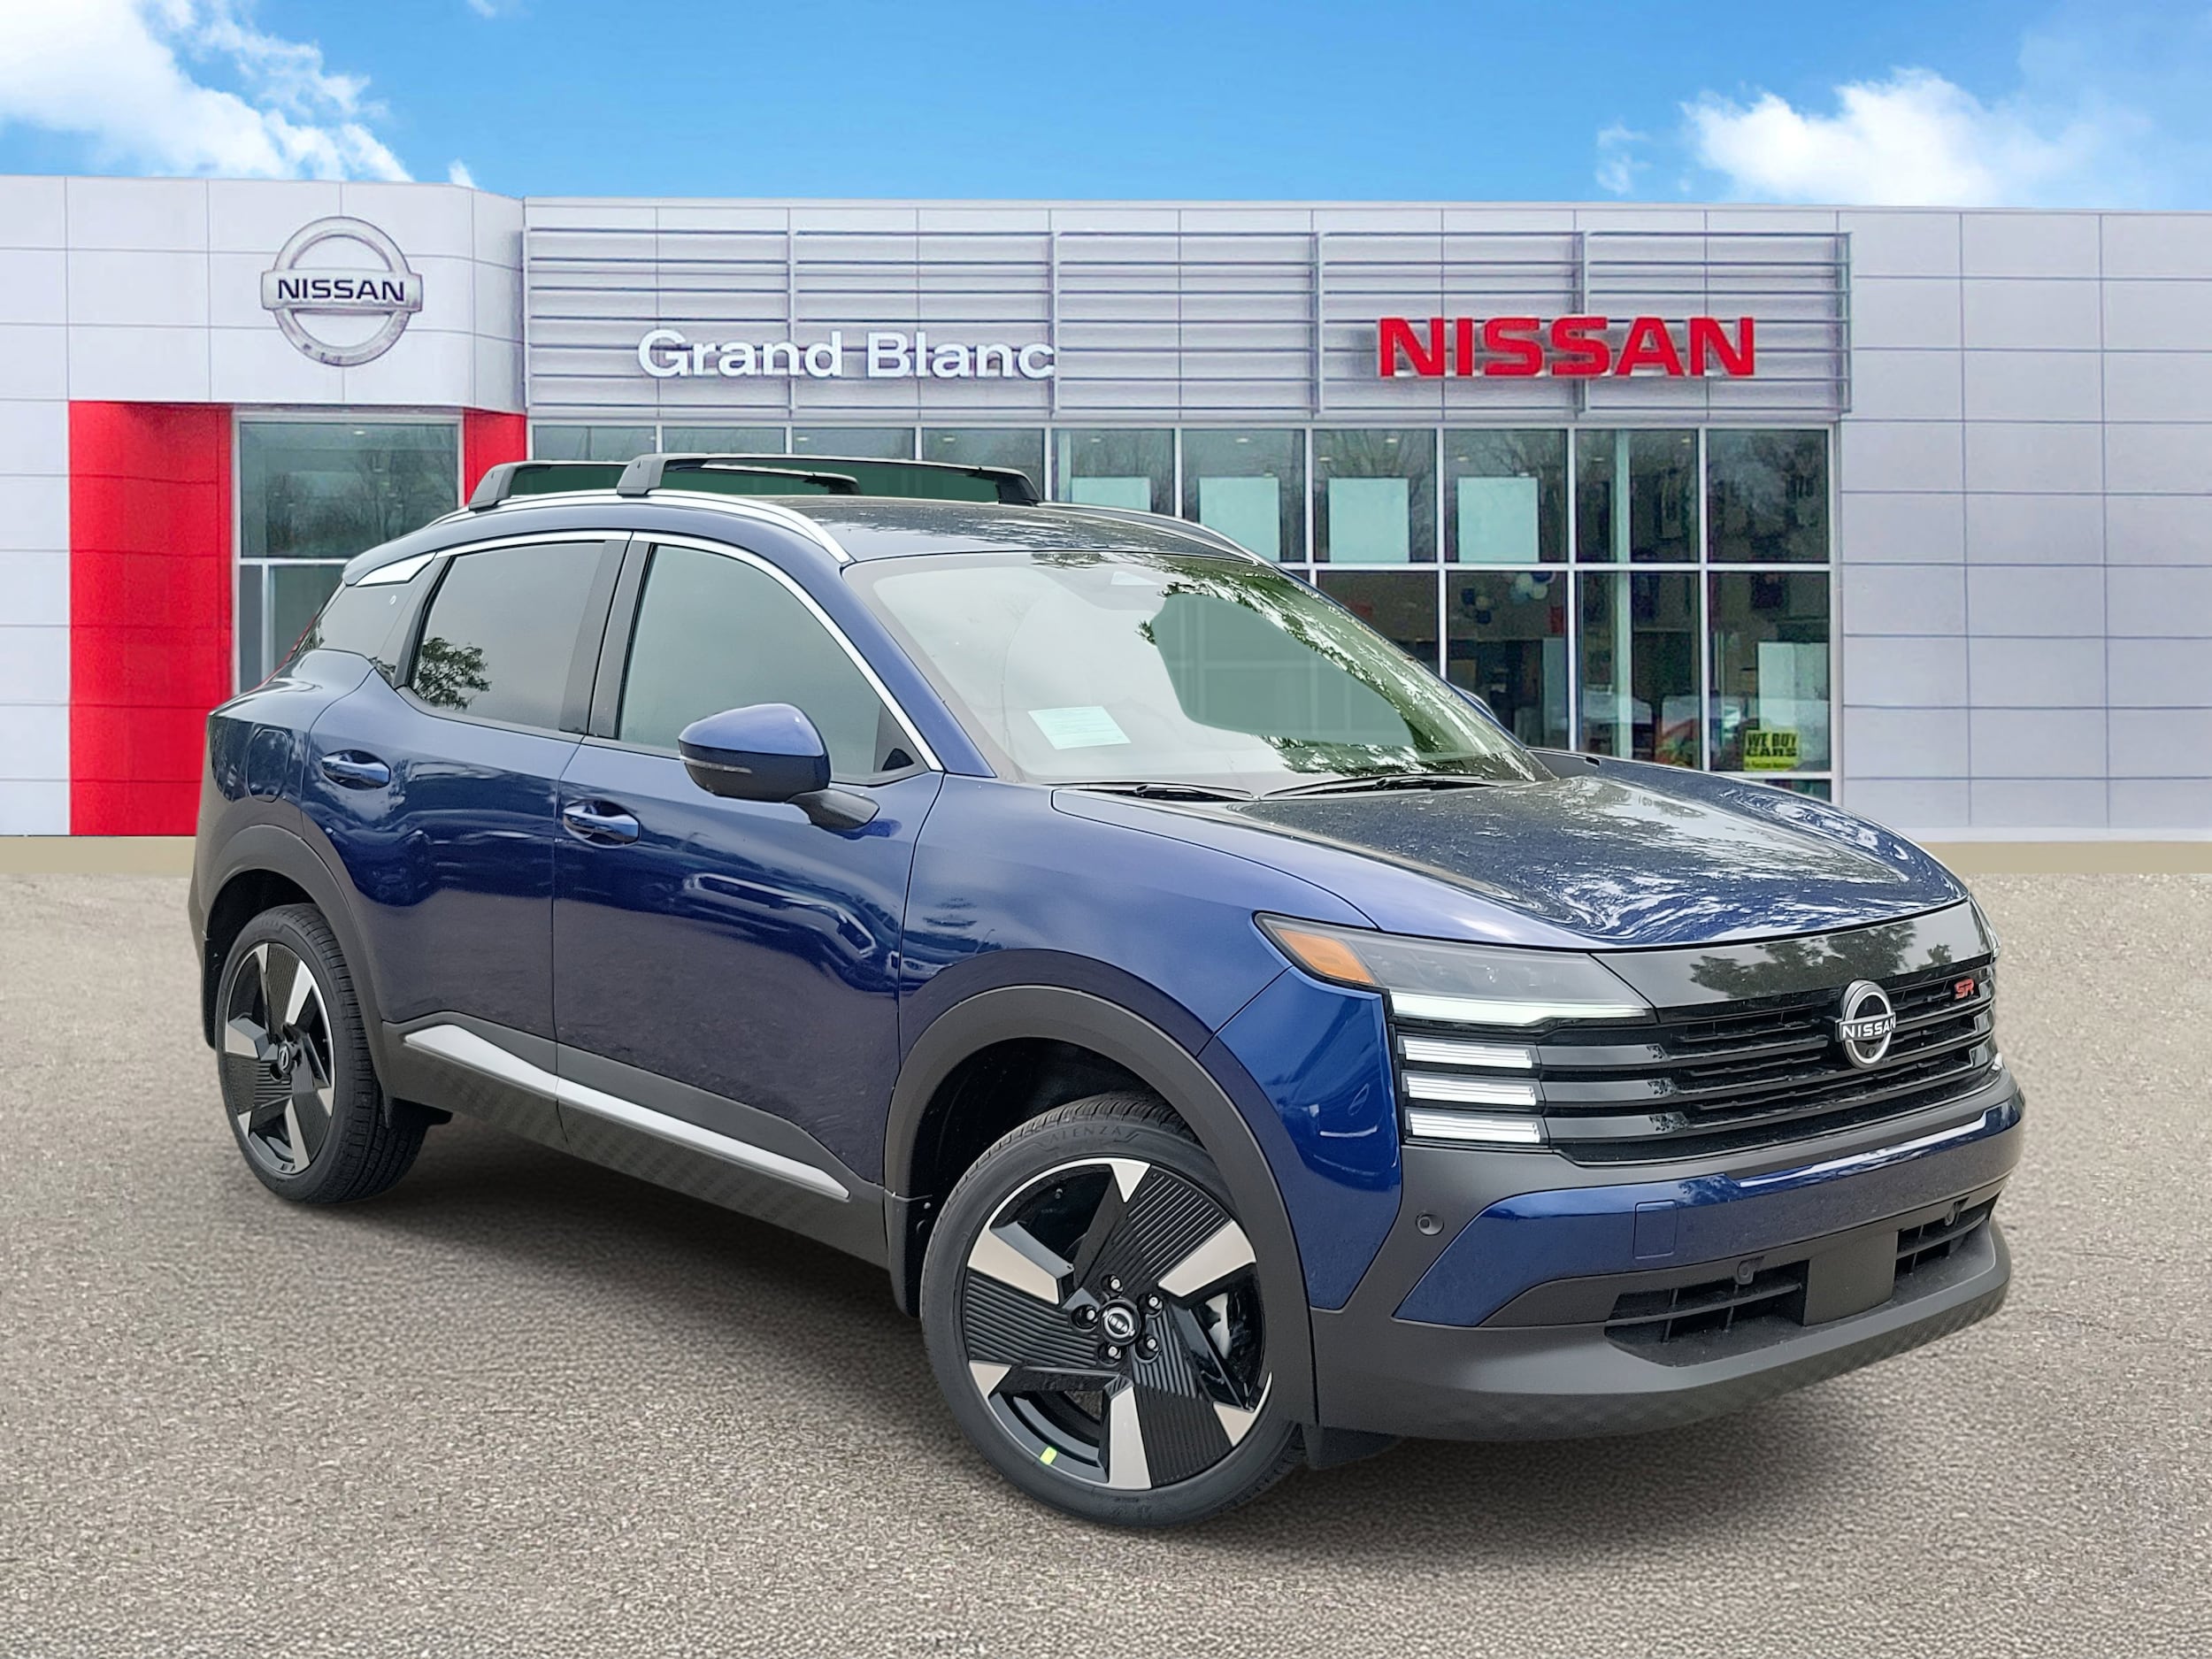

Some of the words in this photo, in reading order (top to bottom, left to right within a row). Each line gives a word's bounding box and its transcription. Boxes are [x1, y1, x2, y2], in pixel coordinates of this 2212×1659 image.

[277, 278, 404, 302] NISSAN
[637, 328, 842, 378] Grand
[866, 330, 1056, 380] Blanc
[1379, 316, 1755, 377] NISSAN
[1747, 733, 1768, 748] WE
[1771, 733, 1797, 748] BUY
[1746, 748, 1797, 757] CARS
[1841, 1017, 1896, 1040] NISSAN
